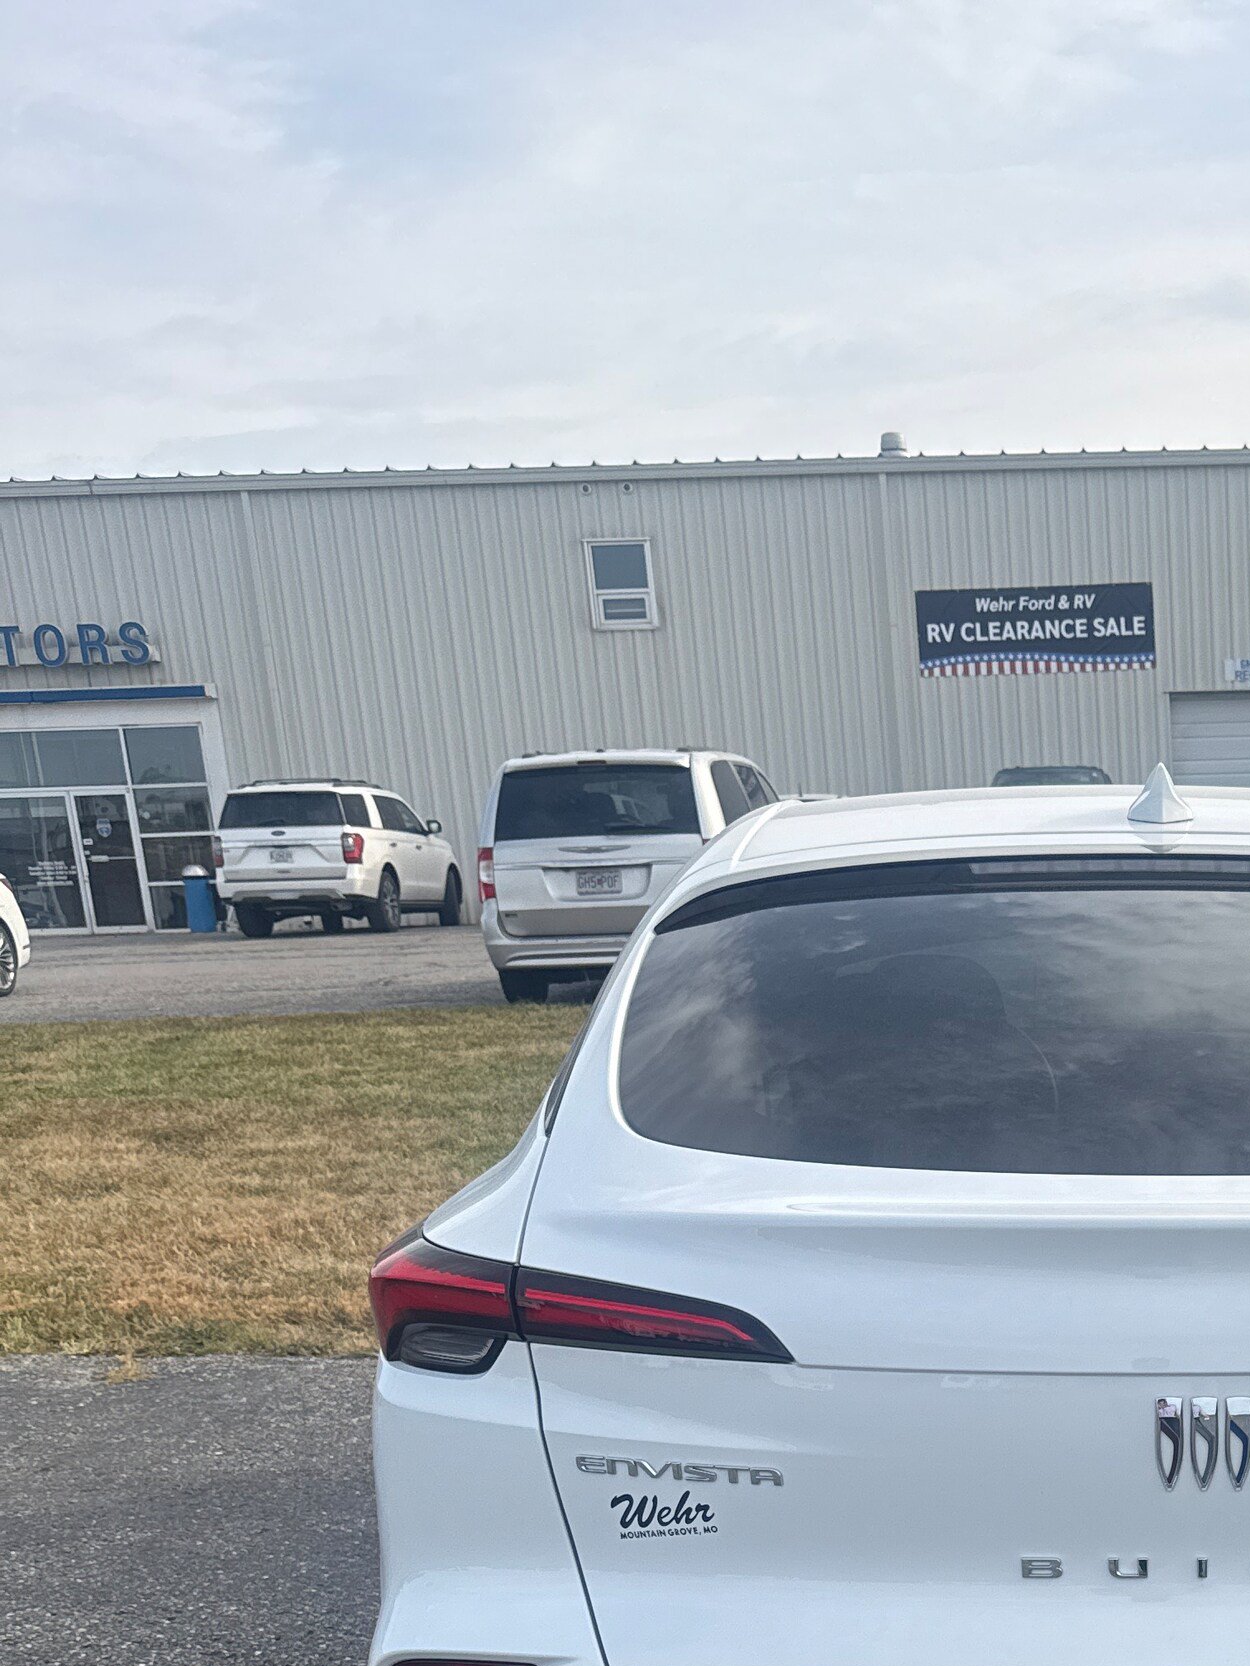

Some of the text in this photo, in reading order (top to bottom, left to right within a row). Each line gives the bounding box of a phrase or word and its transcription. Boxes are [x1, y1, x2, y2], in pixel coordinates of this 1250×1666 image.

[975, 593, 1096, 613] Wehr Ford & RV
[0, 621, 150, 667] TORS
[926, 616, 1147, 643] RV CLEARANCE SALE
[575, 1453, 784, 1487] ENVISTA
[610, 1490, 715, 1529] Wehr
[620, 1525, 718, 1540] MOUNTAIN GROVE, MO
